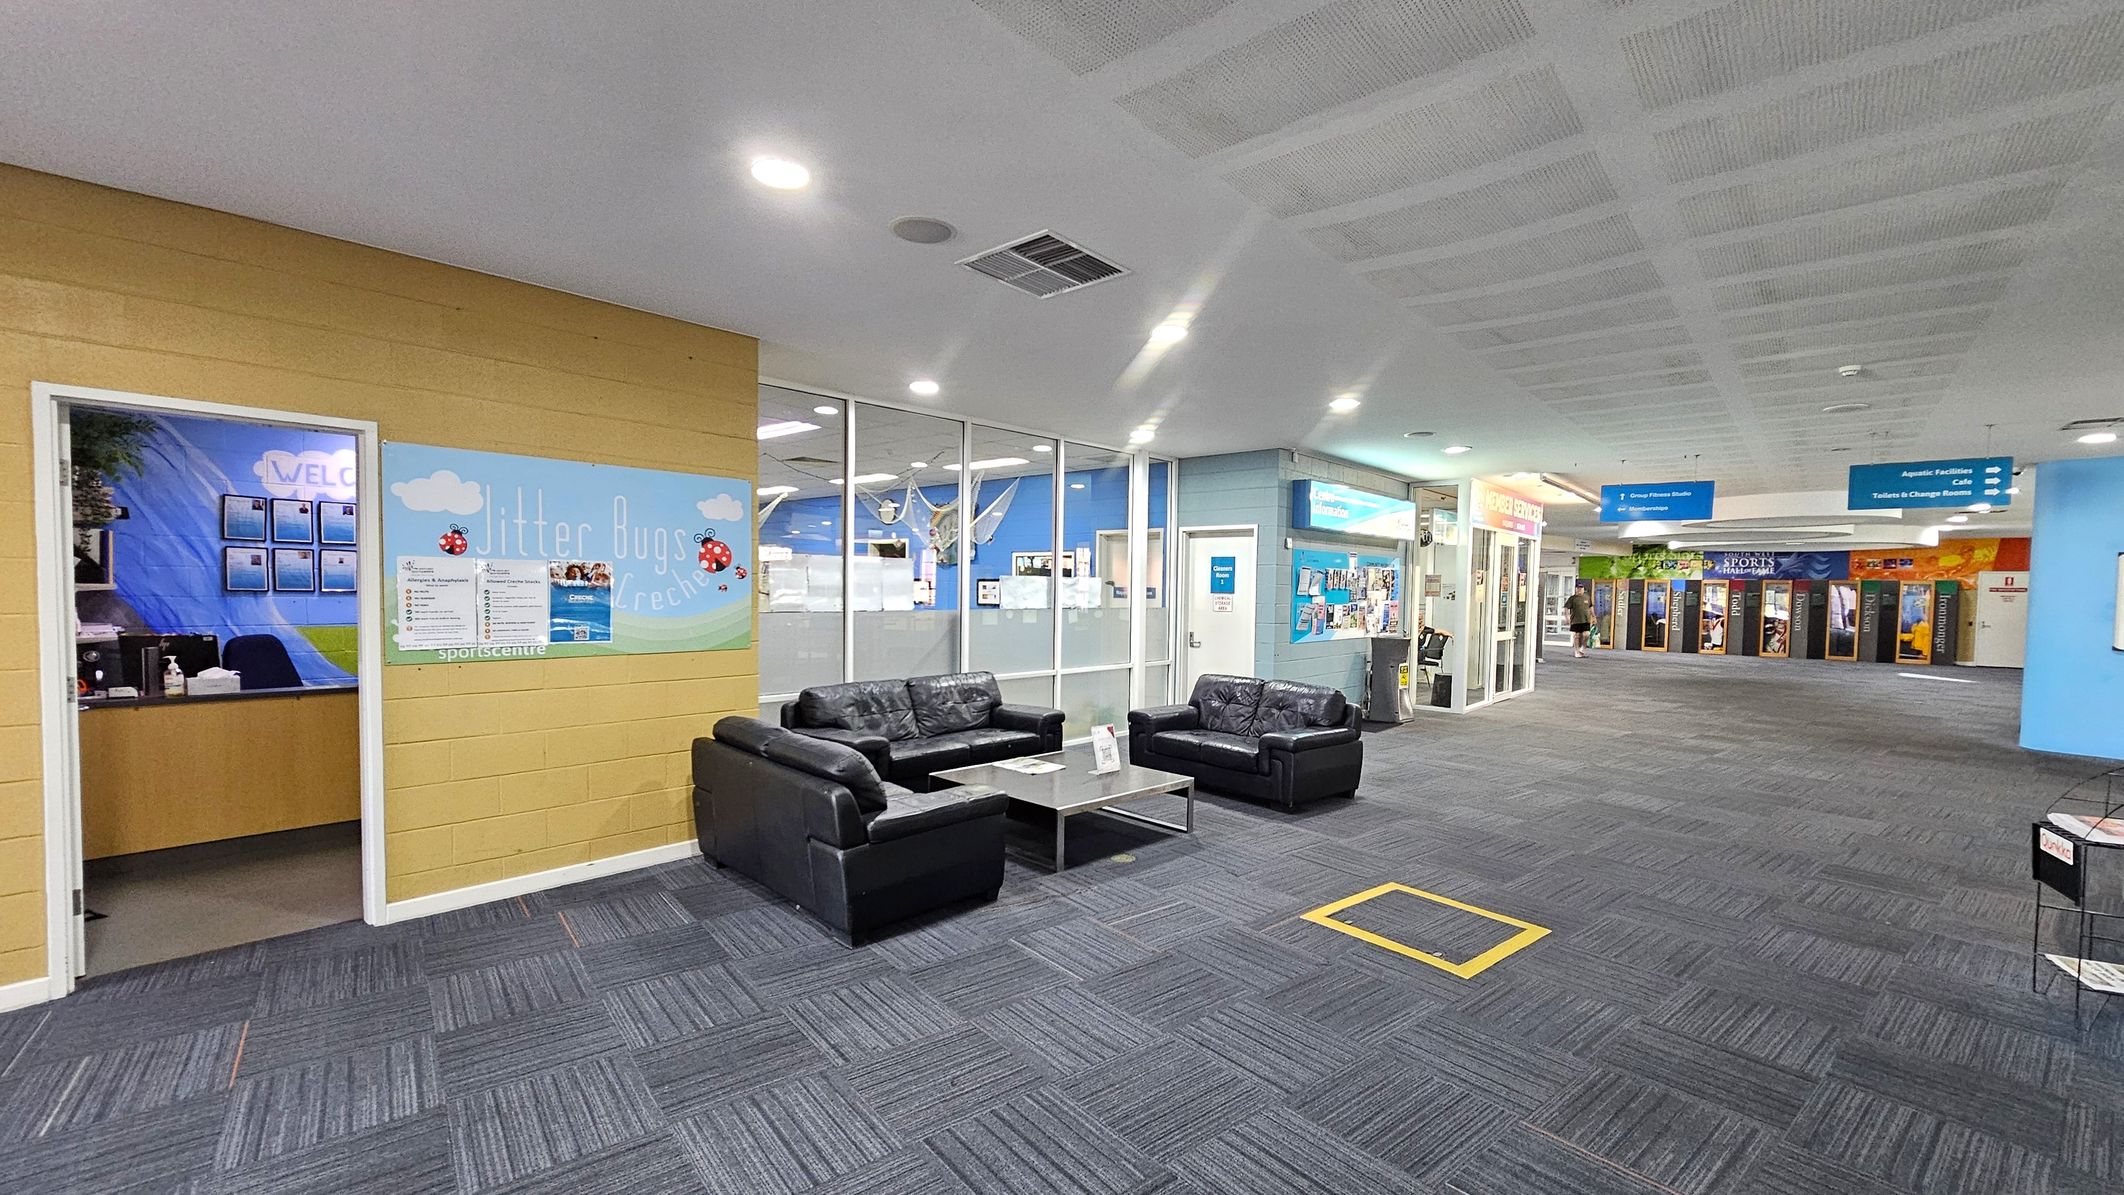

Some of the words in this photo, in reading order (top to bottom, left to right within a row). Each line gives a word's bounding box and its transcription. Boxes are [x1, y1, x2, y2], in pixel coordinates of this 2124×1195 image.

[1901, 469, 1934, 478] Aquatic
[1935, 467, 1973, 476] Facilities
[1952, 478, 1973, 486] Cafe
[1485, 489, 1513, 516] MEMBER
[1514, 498, 1541, 523] SERVICES
[1872, 491, 1900, 499] Toilets
[1909, 490, 1940, 498] Change
[476, 484, 592, 558] Jitter
[613, 495, 687, 576] Bugs
[1723, 557, 1775, 568] SPORTS
[1751, 567, 1775, 575] FAME
[614, 569, 710, 611] Creche
[1671, 591, 1682, 631] Shepherd
[1731, 593, 1742, 616] Todd
[1794, 592, 1806, 631] Dowson
[1863, 593, 1876, 633] Dickson
[1935, 594, 1952, 654] Ironmonger
[438, 645, 547, 662] sportscentre
